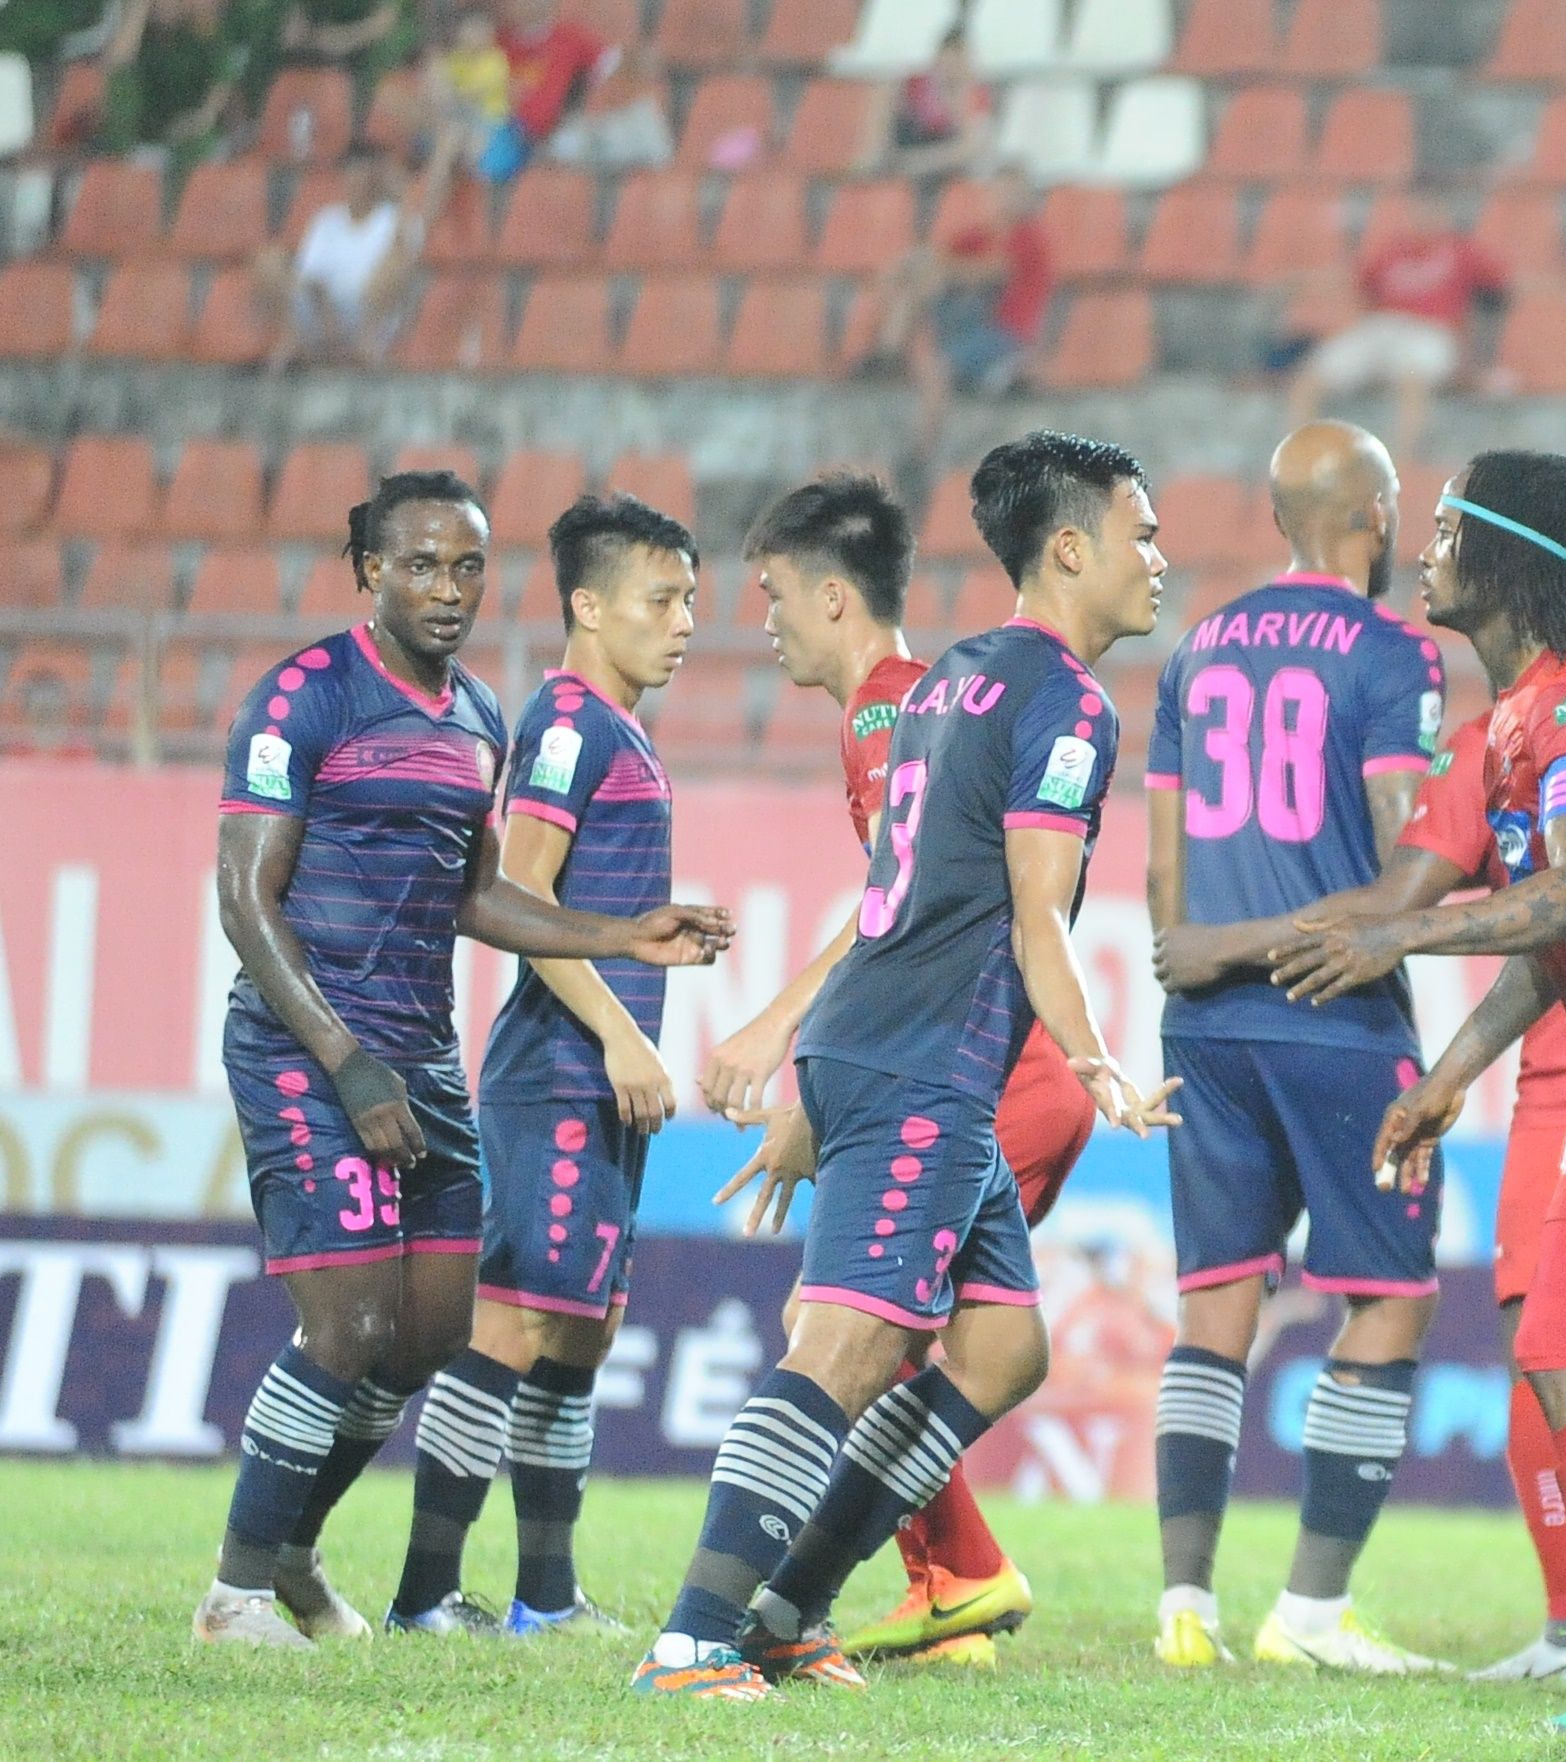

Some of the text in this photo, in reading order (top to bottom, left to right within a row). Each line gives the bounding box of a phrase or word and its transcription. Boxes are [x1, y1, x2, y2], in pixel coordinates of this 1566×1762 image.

[1192, 612, 1362, 655] MARVIN
[1185, 665, 1329, 843] 38
[859, 760, 928, 938] 3
[587, 1223, 620, 1293] 7
